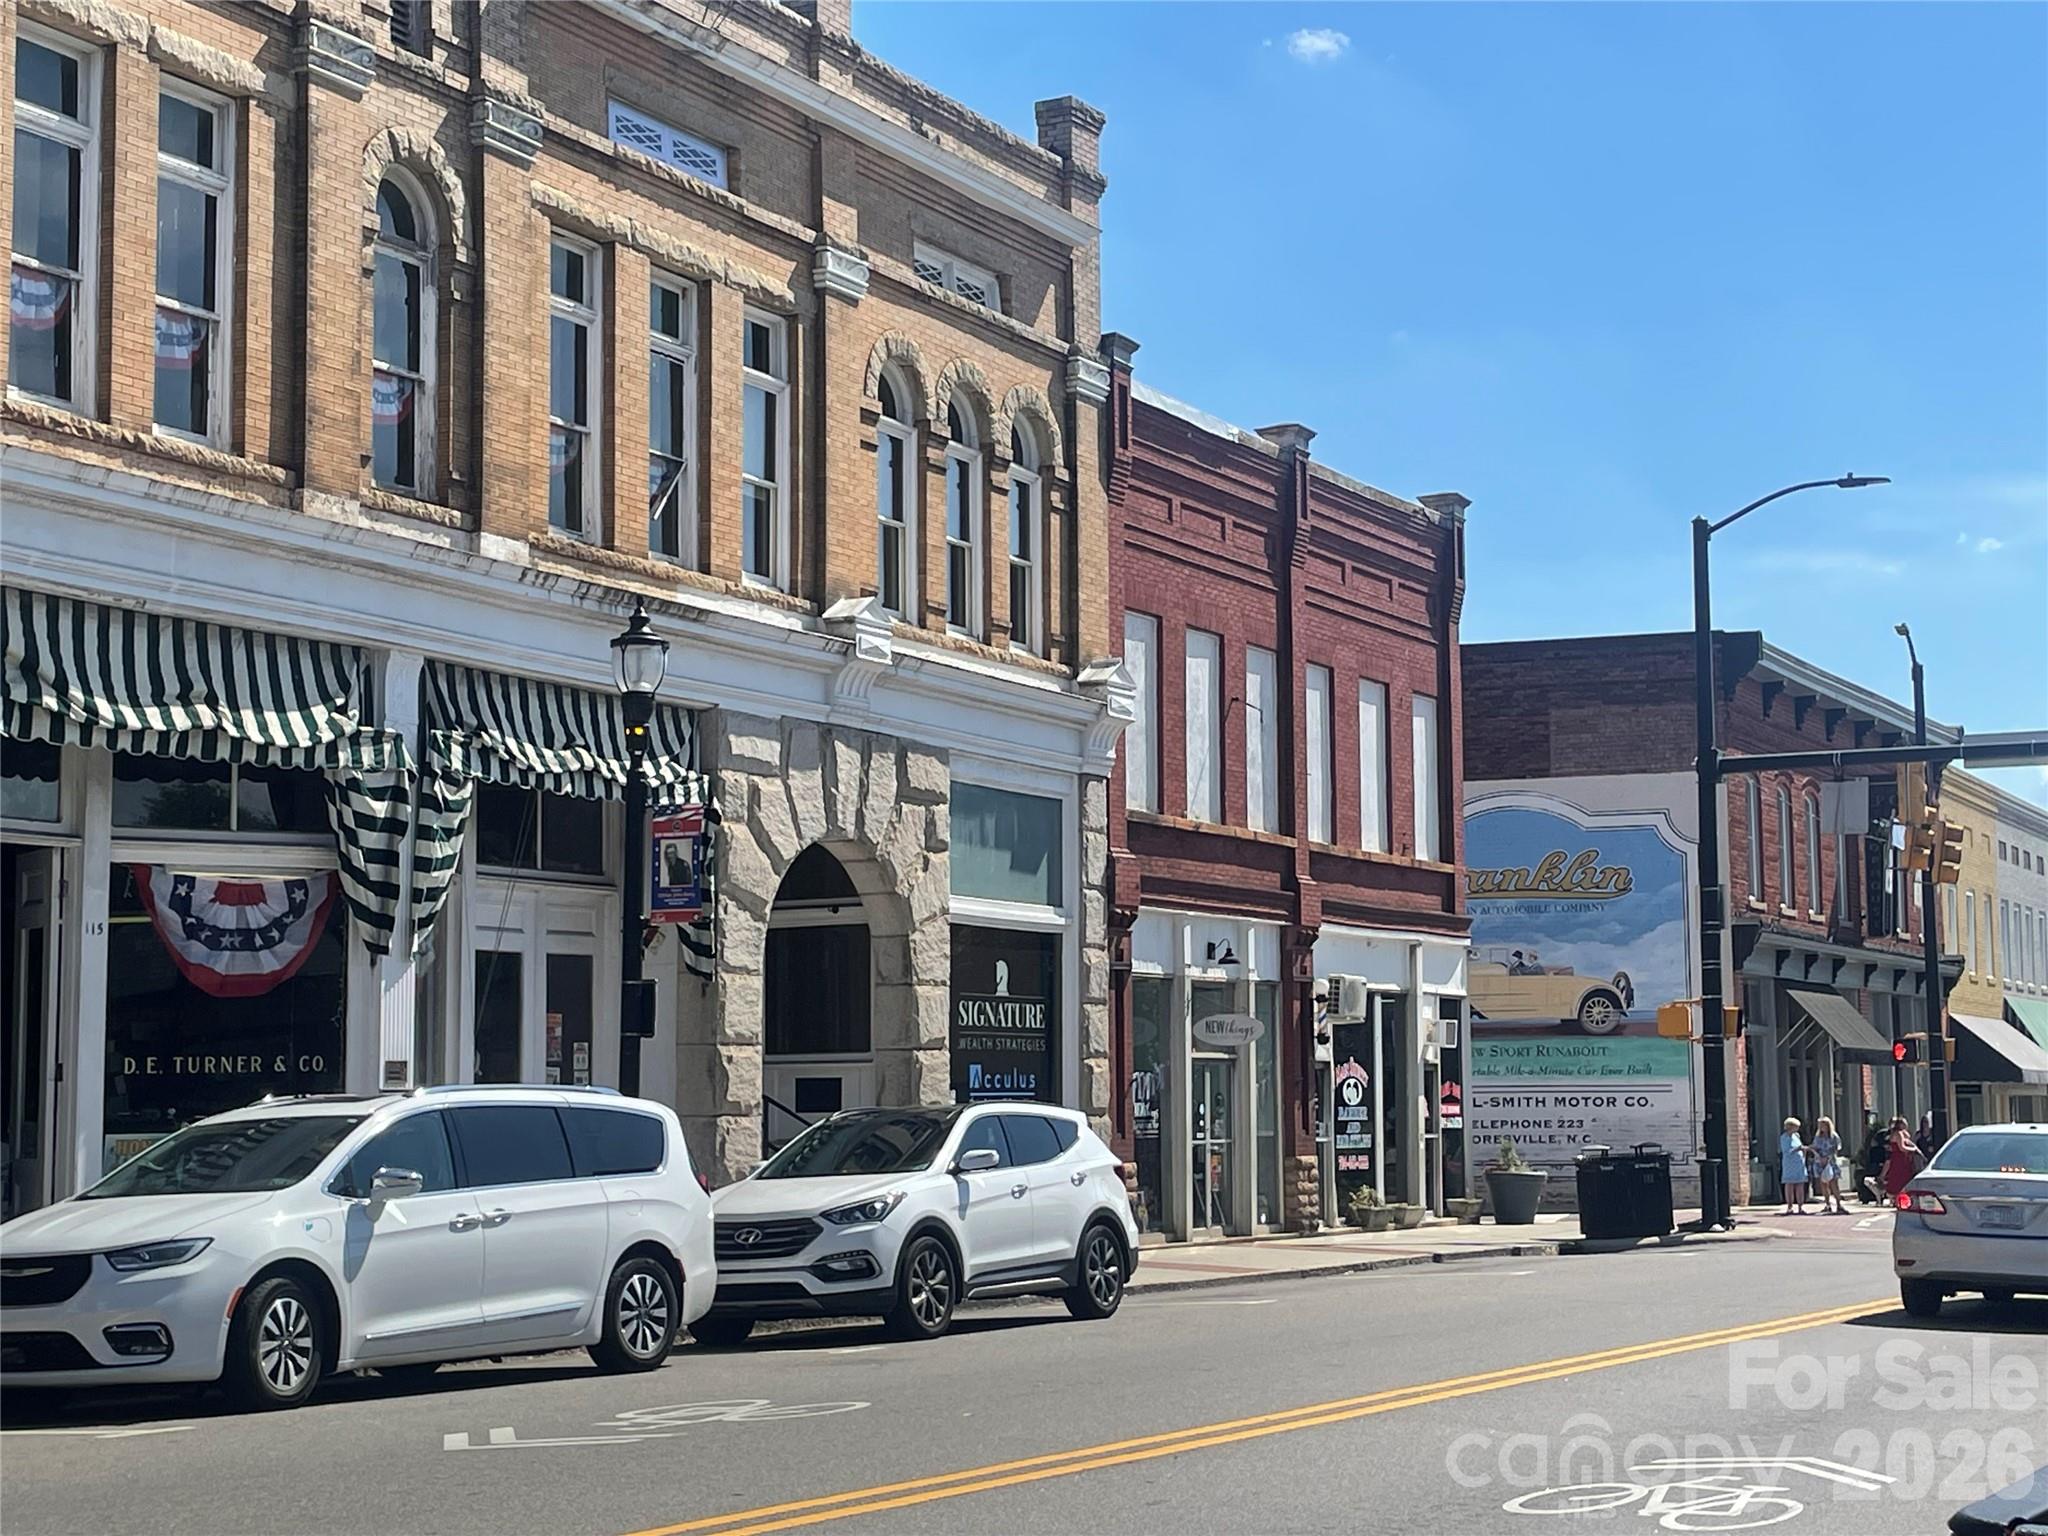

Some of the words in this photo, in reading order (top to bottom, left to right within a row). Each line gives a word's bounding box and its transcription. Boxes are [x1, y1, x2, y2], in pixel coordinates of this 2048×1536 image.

[1480, 903, 1550, 915] AUTOMOBILE
[1554, 902, 1606, 913] COMPANY
[85, 921, 104, 936] 115
[958, 1000, 1045, 1029] SIGNATURE
[1205, 1020, 1225, 1035] NEW
[958, 1038, 993, 1050] WEALTH
[996, 1039, 1046, 1051] STRATEGIES
[1489, 1044, 1532, 1057] SPORT
[1536, 1044, 1609, 1057] RUNABOUT
[173, 1056, 262, 1074] TURNER
[274, 1055, 287, 1072] &
[299, 1055, 328, 1073] CO.
[1627, 1063, 1652, 1075] Built
[969, 1064, 1036, 1088] Acculus
[1472, 1096, 1546, 1108] L-SMITH
[1554, 1096, 1617, 1108] MOTOR
[1624, 1096, 1655, 1108] CO.
[1472, 1119, 1552, 1129] ELEPHONE
[1558, 1119, 1584, 1129] 223
